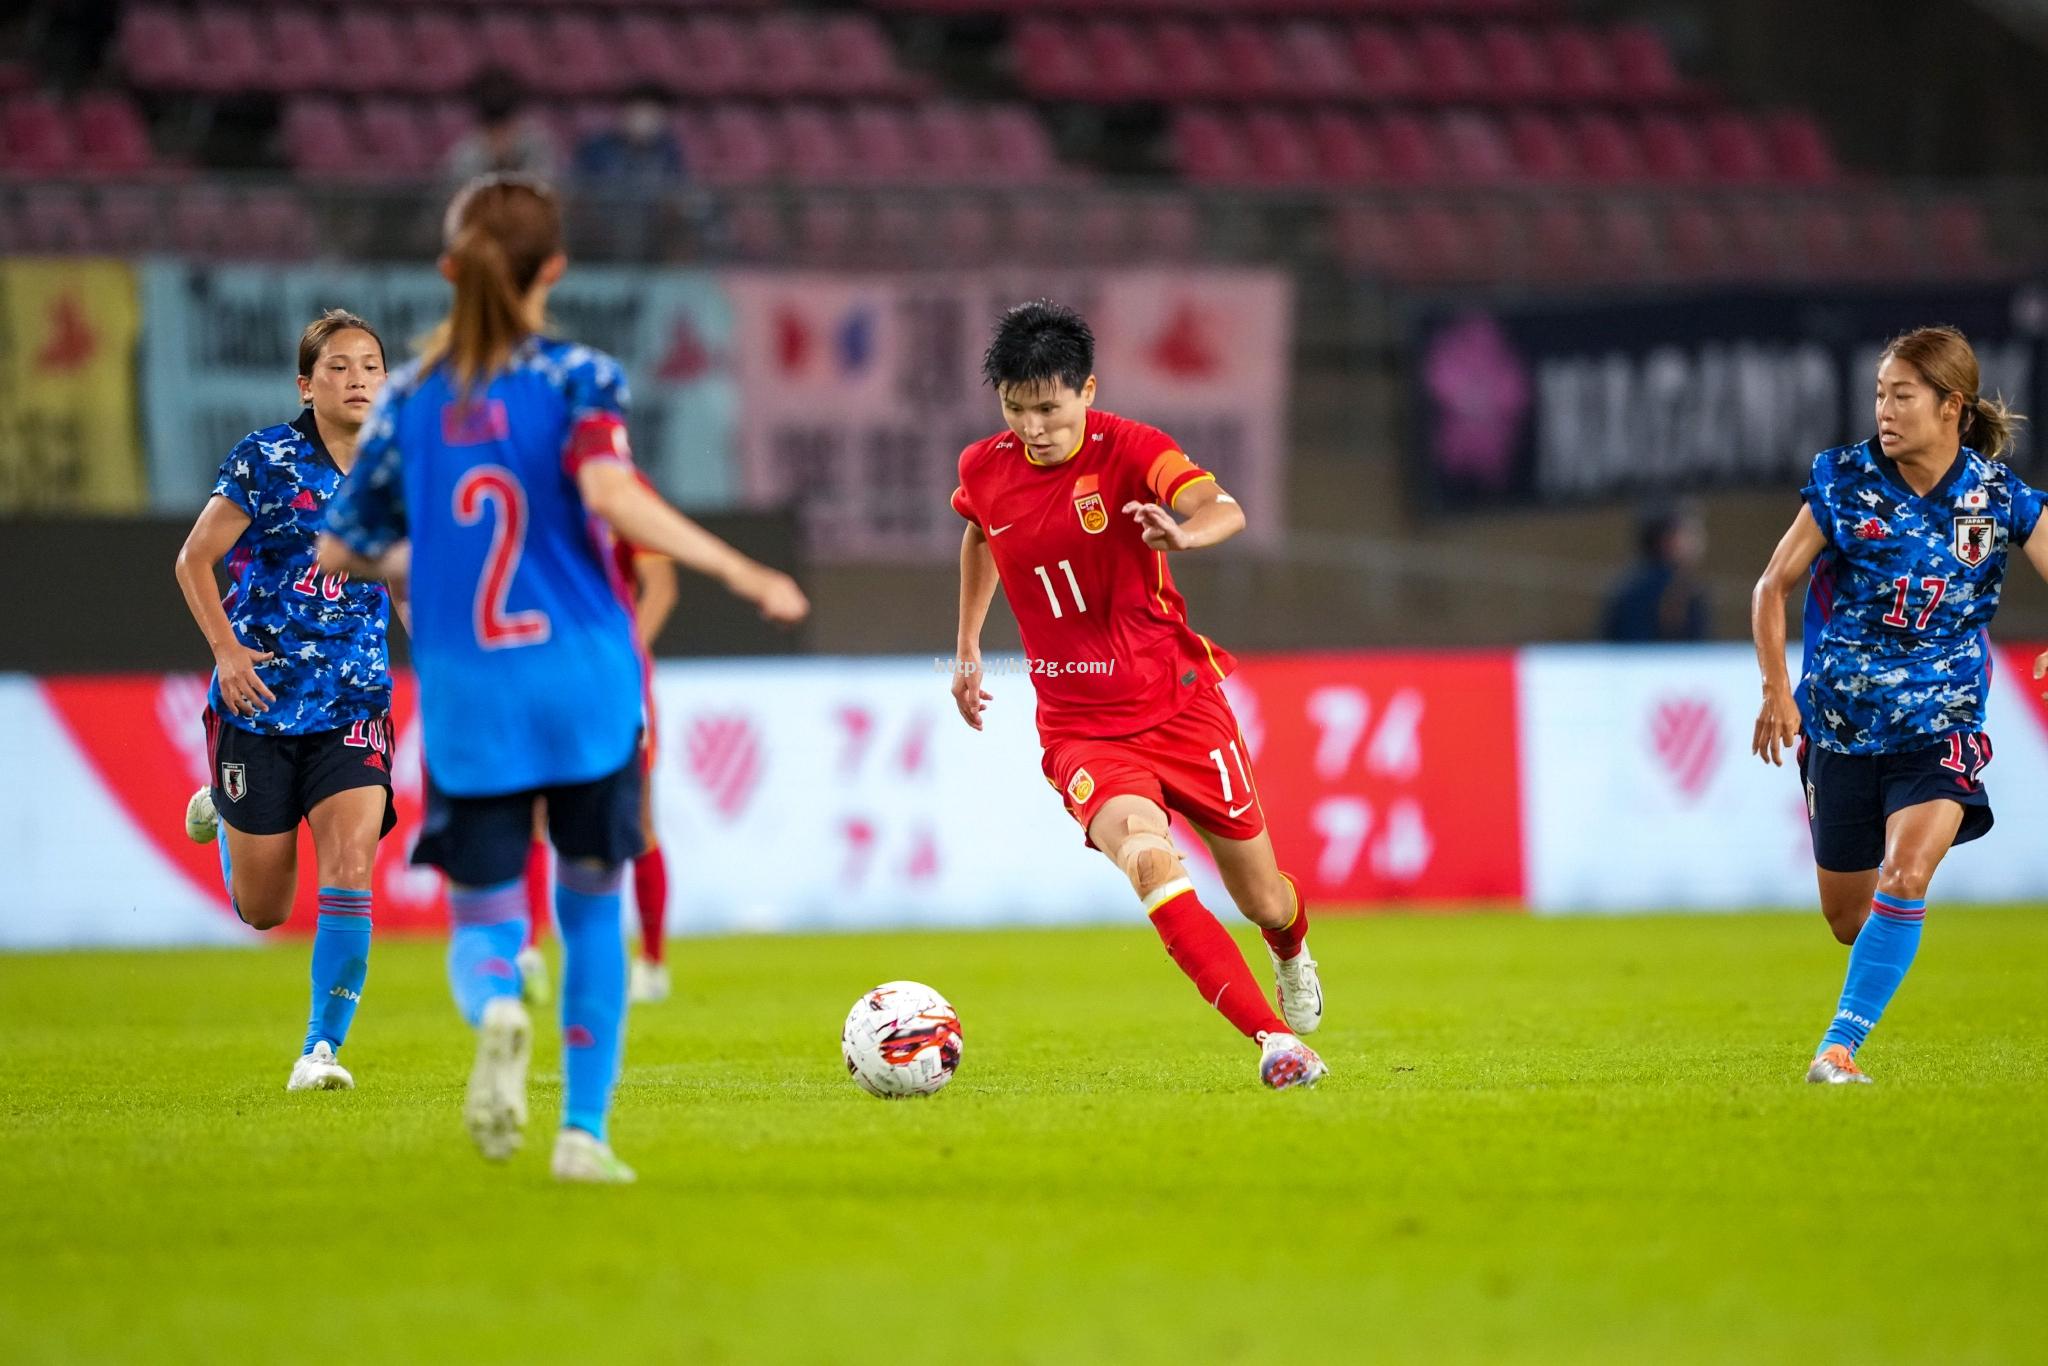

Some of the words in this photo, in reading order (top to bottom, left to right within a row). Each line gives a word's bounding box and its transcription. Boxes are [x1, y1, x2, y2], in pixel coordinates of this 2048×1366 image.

[452, 463, 551, 652] 2
[1034, 559, 1087, 619] 11
[1882, 575, 1947, 630] 17
[1209, 740, 1251, 803] 11
[330, 986, 361, 1005] JAPA
